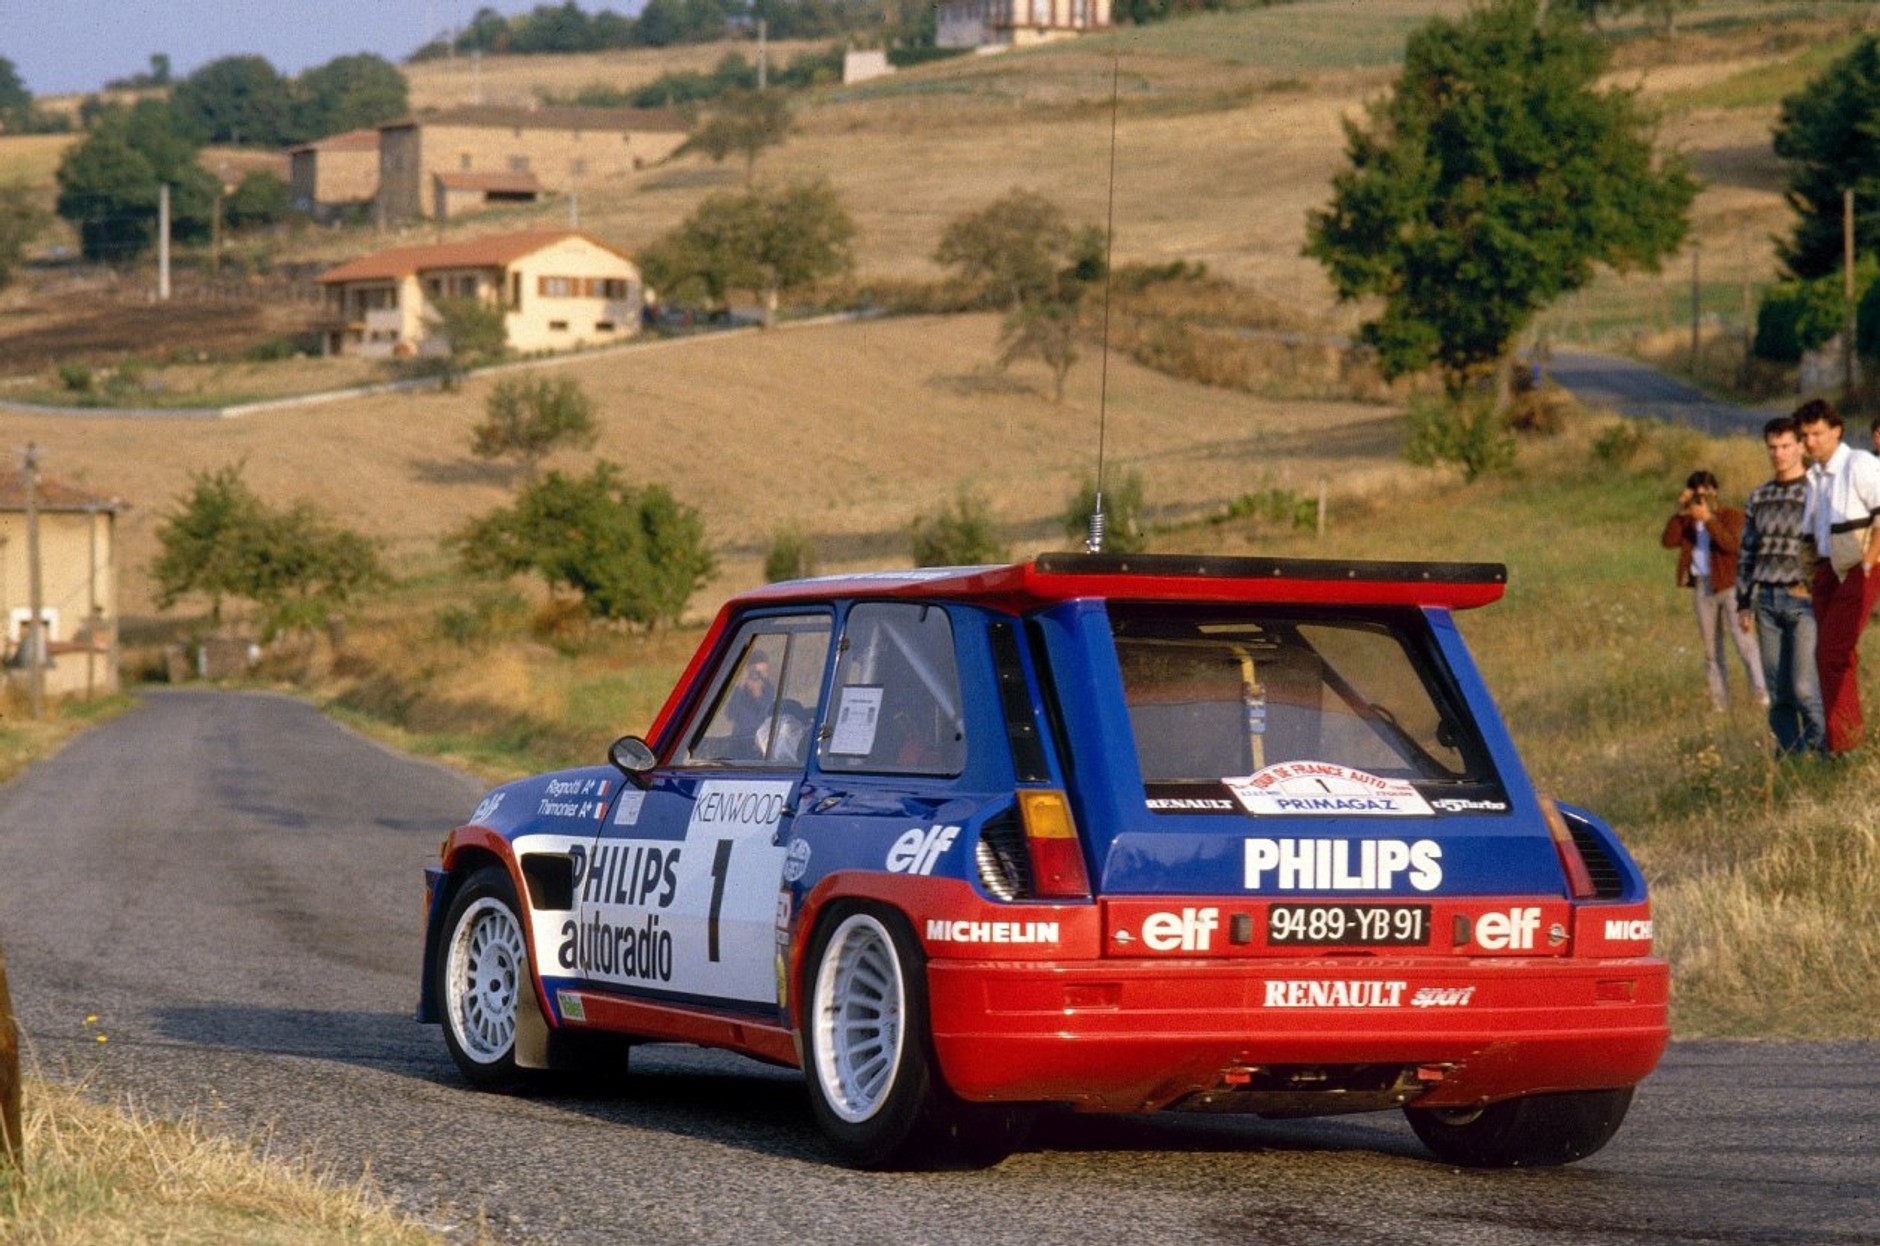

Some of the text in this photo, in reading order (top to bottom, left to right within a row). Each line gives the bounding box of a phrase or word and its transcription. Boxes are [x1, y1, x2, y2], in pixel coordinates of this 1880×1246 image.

[1291, 761, 1345, 777] FRANCE
[1351, 771, 1387, 790] AUTO
[1314, 778, 1331, 794] 1
[693, 793, 784, 825] KENWOOD
[1145, 799, 1233, 809] RENAULT
[1276, 799, 1399, 811] PRIMAGAZ
[886, 824, 961, 876] elf
[1244, 838, 1443, 891] PHILIPS
[570, 844, 681, 908] PHILIPS
[708, 839, 733, 962] 1
[926, 919, 1059, 943] MICHELIN
[1141, 909, 1219, 951] elf
[1475, 908, 1541, 949] elf
[1604, 920, 1653, 940] MICH
[558, 910, 673, 982] autoradio
[1263, 981, 1476, 1008] RENAULT sport
